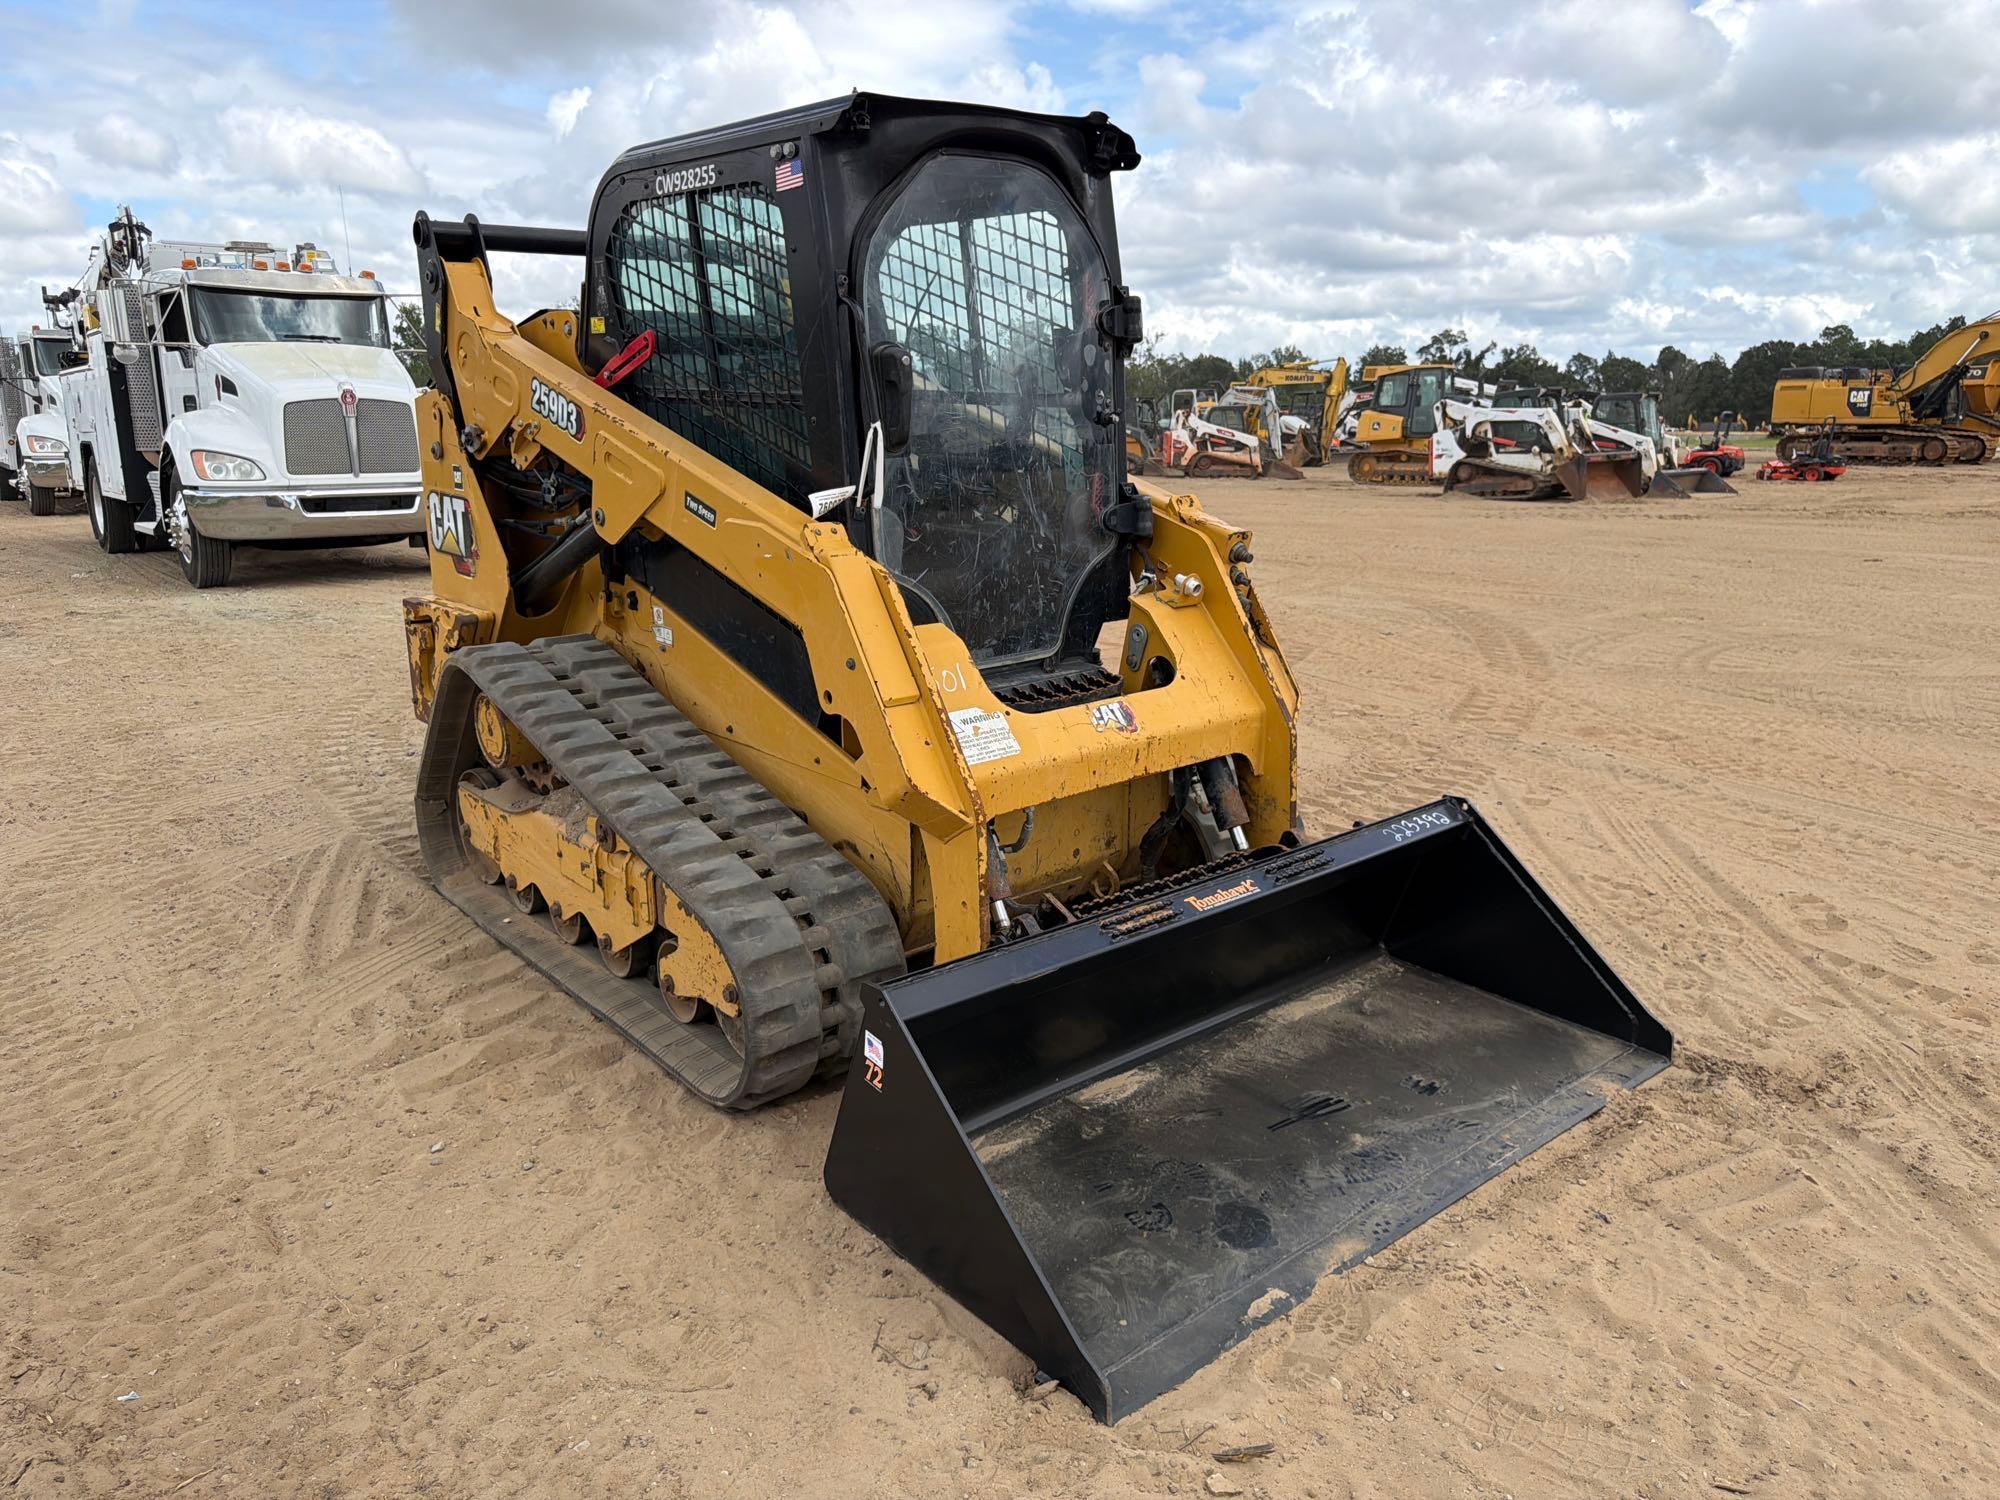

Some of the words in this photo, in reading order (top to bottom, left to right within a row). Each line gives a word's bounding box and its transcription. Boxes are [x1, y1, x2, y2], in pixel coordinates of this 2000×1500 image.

[656, 164, 716, 195] CW928255
[531, 378, 577, 436] 259D3
[1850, 390, 1870, 403] CAT
[429, 492, 465, 558] CAT
[960, 711, 1001, 726] WARNING
[1184, 879, 1259, 912] Tomahawk
[865, 1059, 883, 1089] 72
